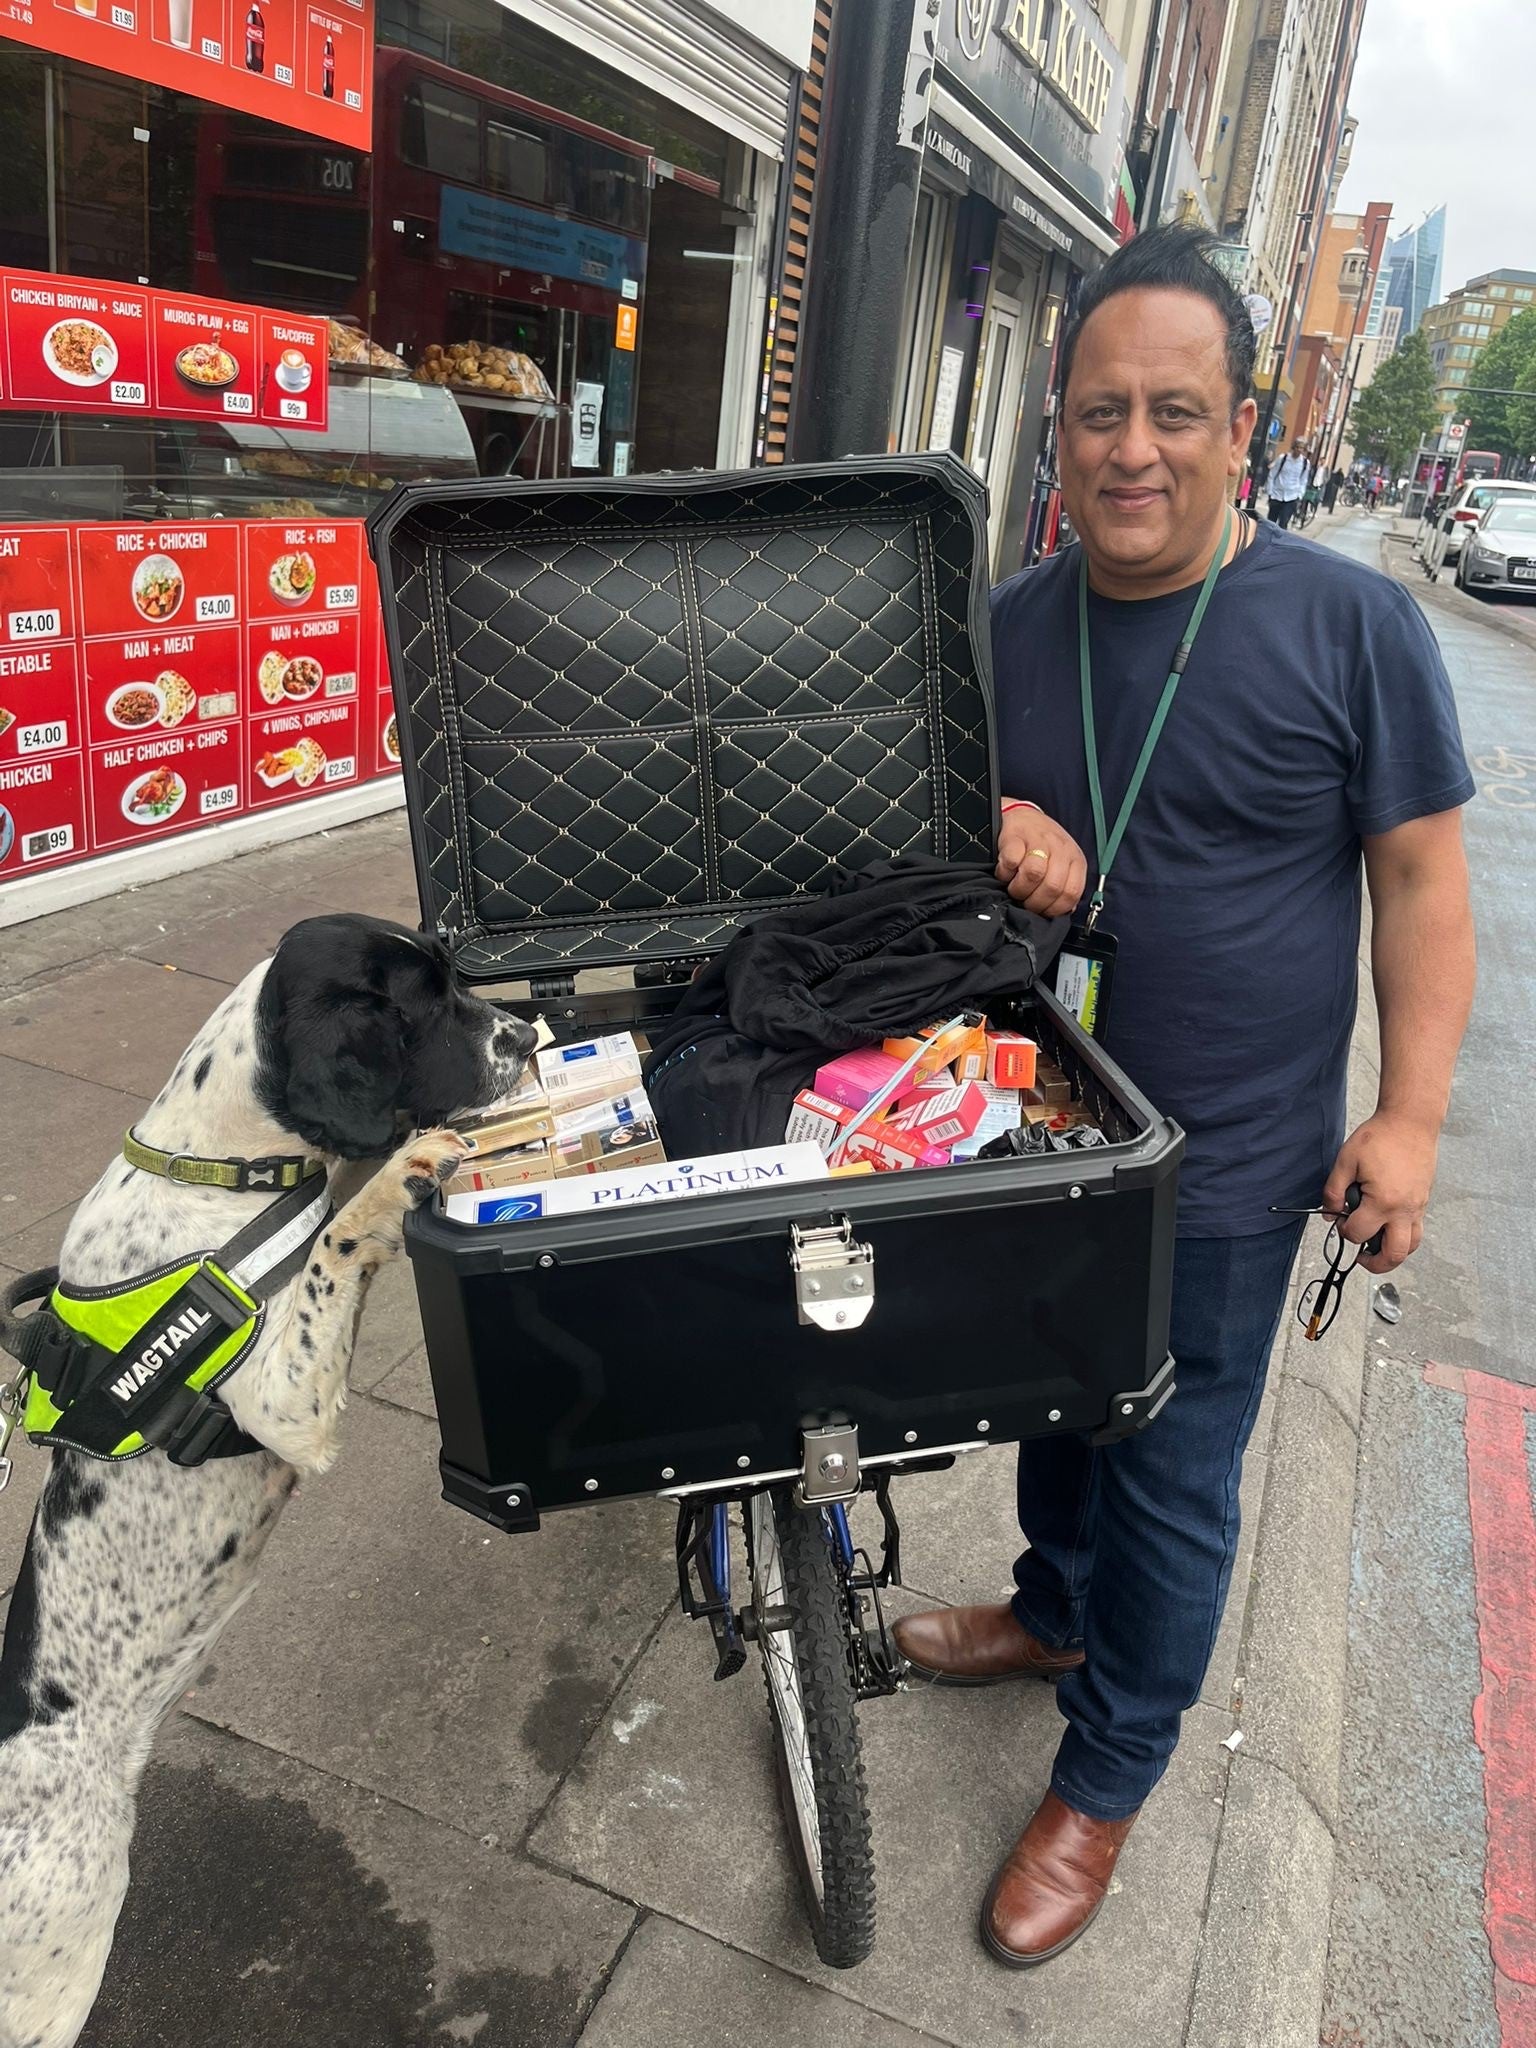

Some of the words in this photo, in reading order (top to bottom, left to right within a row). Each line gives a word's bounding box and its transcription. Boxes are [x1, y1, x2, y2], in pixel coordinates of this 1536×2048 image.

[9, 5, 33, 25] £1.49
[115, 10, 133, 26] £1.99
[11, 287, 55, 307] CHICKEN
[57, 292, 99, 313] BIRIYANI
[101, 303, 108, 313] +
[112, 300, 143, 319] SAUCE
[163, 308, 195, 328] MUROG
[196, 313, 223, 330] PILAW
[224, 321, 231, 331] +
[233, 318, 249, 334] EGG
[272, 326, 316, 346] TEA/COFFEE
[115, 385, 142, 401] £2.00
[227, 396, 250, 410] £4.00
[286, 403, 301, 416] 99p
[116, 535, 146, 553] RICE
[147, 539, 156, 550] +
[159, 532, 207, 551] CHICKEN
[285, 530, 305, 545] RICE
[307, 533, 315, 543] +
[316, 529, 336, 544] FISH
[0, 538, 20, 557] AT
[330, 588, 354, 604] £5.99
[201, 599, 231, 616] £4.00
[15, 614, 54, 634] £4.00
[271, 625, 292, 642] NAN
[292, 628, 300, 638] +
[302, 619, 339, 637] CHICKEN
[124, 642, 150, 660] NAN
[152, 644, 161, 656] +
[164, 635, 195, 655] MEAT
[262, 722, 270, 735] 4
[304, 706, 349, 727] CHIPS/NAN
[24, 726, 61, 748] £4.00
[104, 749, 133, 769] HALF
[136, 738, 185, 761] CHICKEN
[186, 739, 195, 752] +
[197, 729, 228, 748] CHIPS
[328, 761, 352, 777] £2.50
[205, 790, 233, 809] £4.99
[591, 1162, 789, 1204] PLATINUM
[110, 1306, 213, 1402] WAGTAIL
